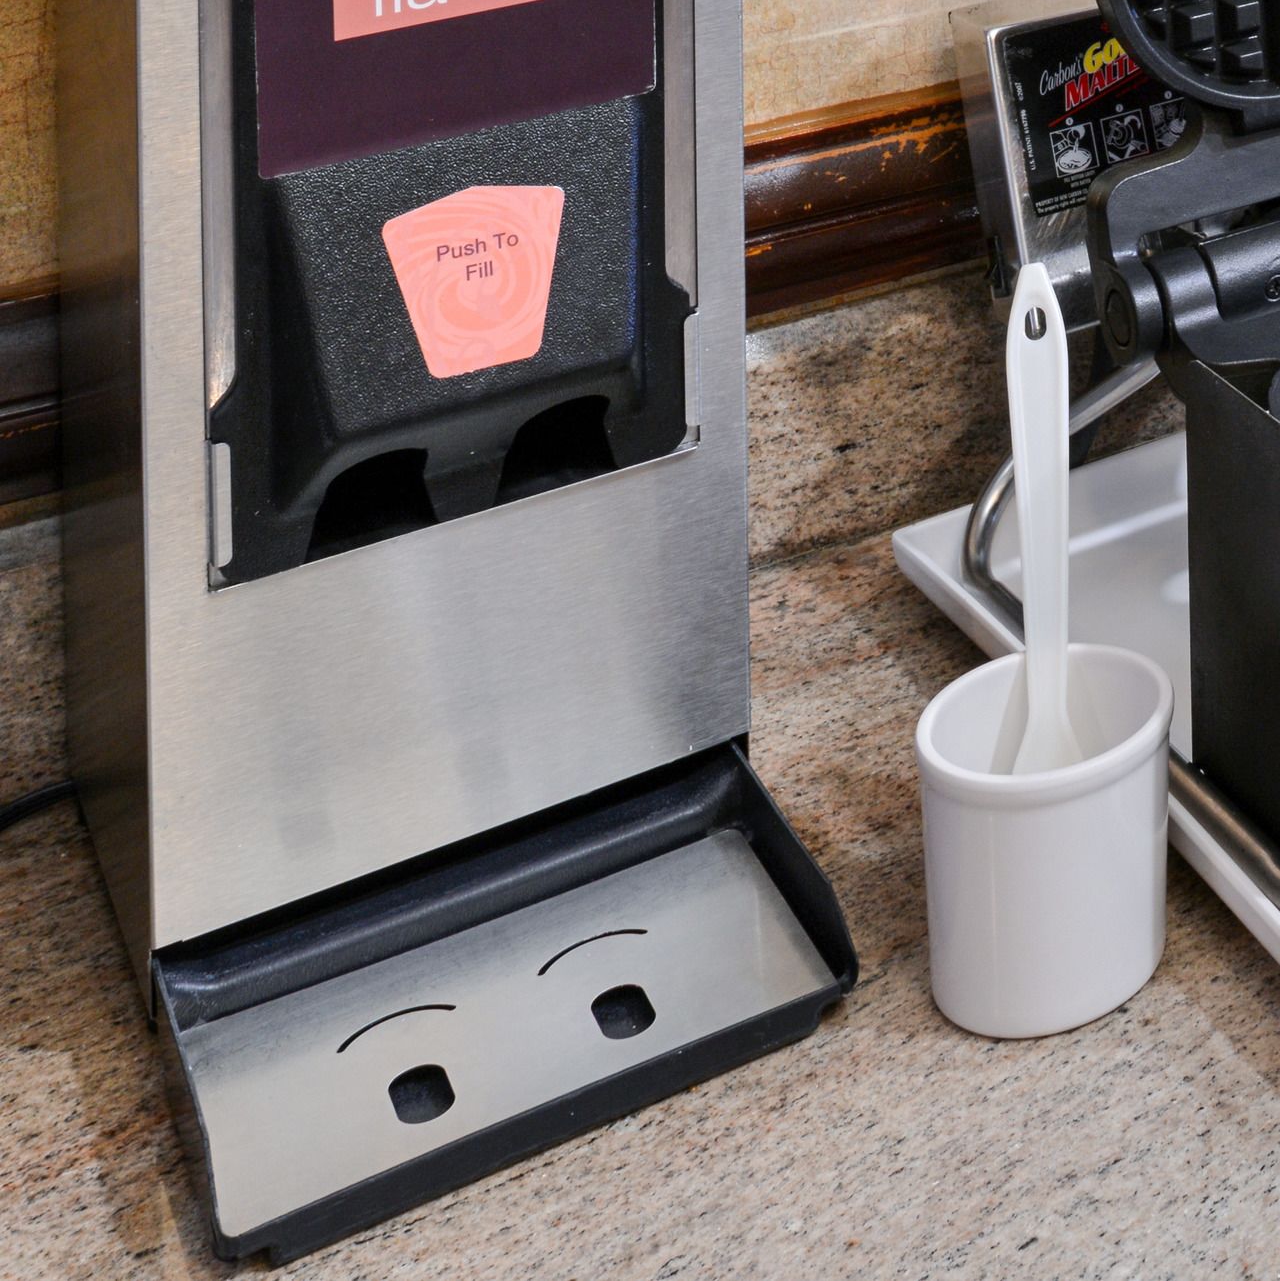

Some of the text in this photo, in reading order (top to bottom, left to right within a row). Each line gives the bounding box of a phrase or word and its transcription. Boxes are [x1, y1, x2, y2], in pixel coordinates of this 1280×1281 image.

[436, 232, 520, 263] Push To
[465, 260, 494, 282] Fill
